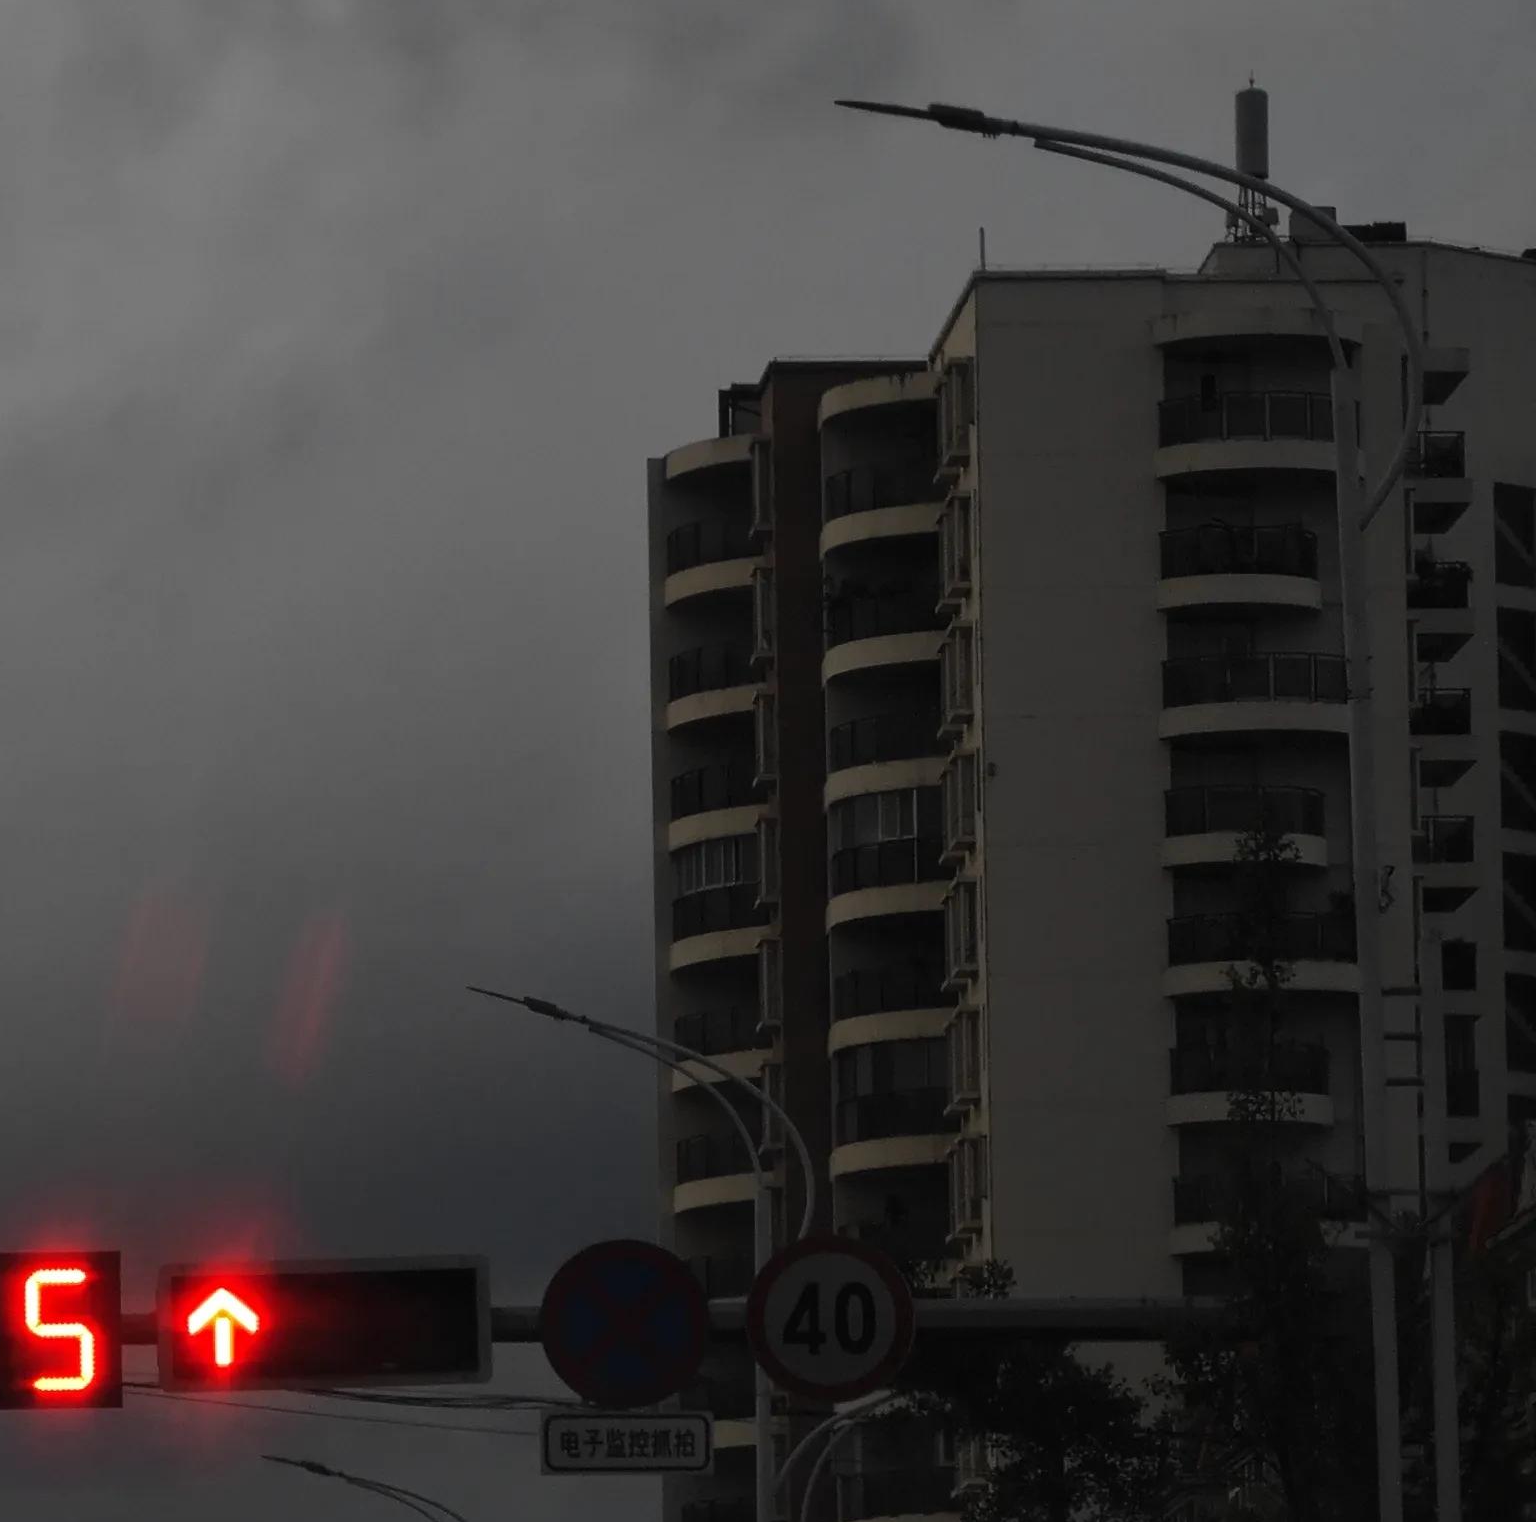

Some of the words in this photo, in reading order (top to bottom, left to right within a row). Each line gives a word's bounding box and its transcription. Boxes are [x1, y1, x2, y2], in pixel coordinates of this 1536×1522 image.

[23, 1267, 95, 1392] 5
[782, 1281, 876, 1356] 40
[560, 1428, 696, 1458] 电子监控抓拍
